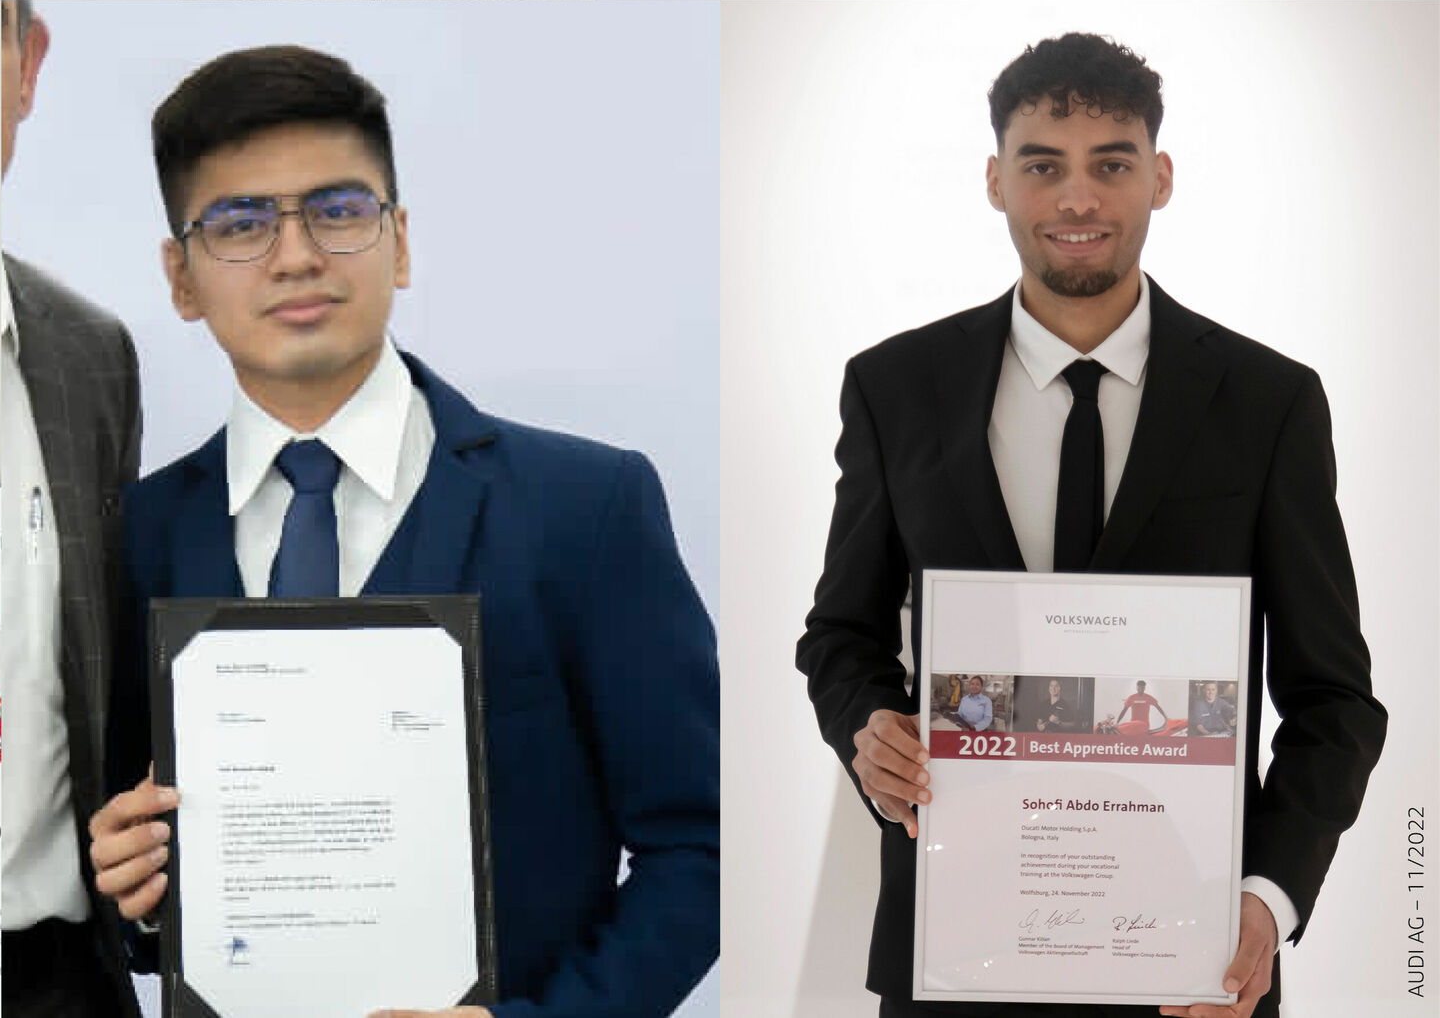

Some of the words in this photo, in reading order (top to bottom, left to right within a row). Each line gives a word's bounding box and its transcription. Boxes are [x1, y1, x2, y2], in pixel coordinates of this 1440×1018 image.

[1045, 615, 1127, 626] VOLKSWAGEN
[959, 735, 1017, 757] 2022
[1030, 741, 1060, 753] Best
[1063, 742, 1139, 758] Apprentice
[1142, 744, 1187, 757] Award
[1066, 799, 1099, 811] Abdo
[1103, 801, 1165, 813] Errahman
